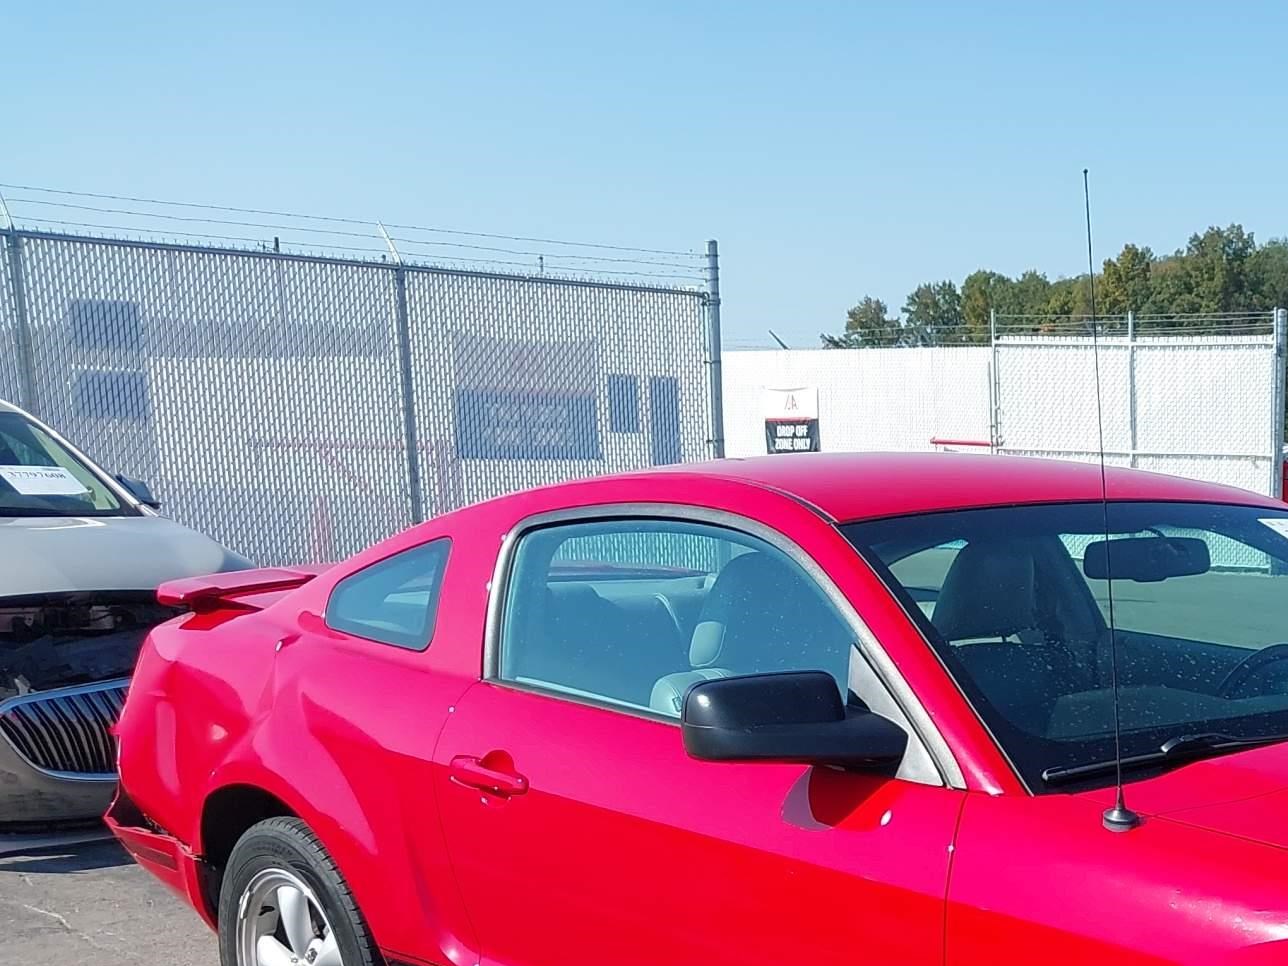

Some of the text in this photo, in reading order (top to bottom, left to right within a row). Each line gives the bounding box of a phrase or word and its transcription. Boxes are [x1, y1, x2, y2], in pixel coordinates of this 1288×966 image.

[776, 424, 809, 438] DROP OFF
[775, 438, 811, 450] ZONE ONLY
